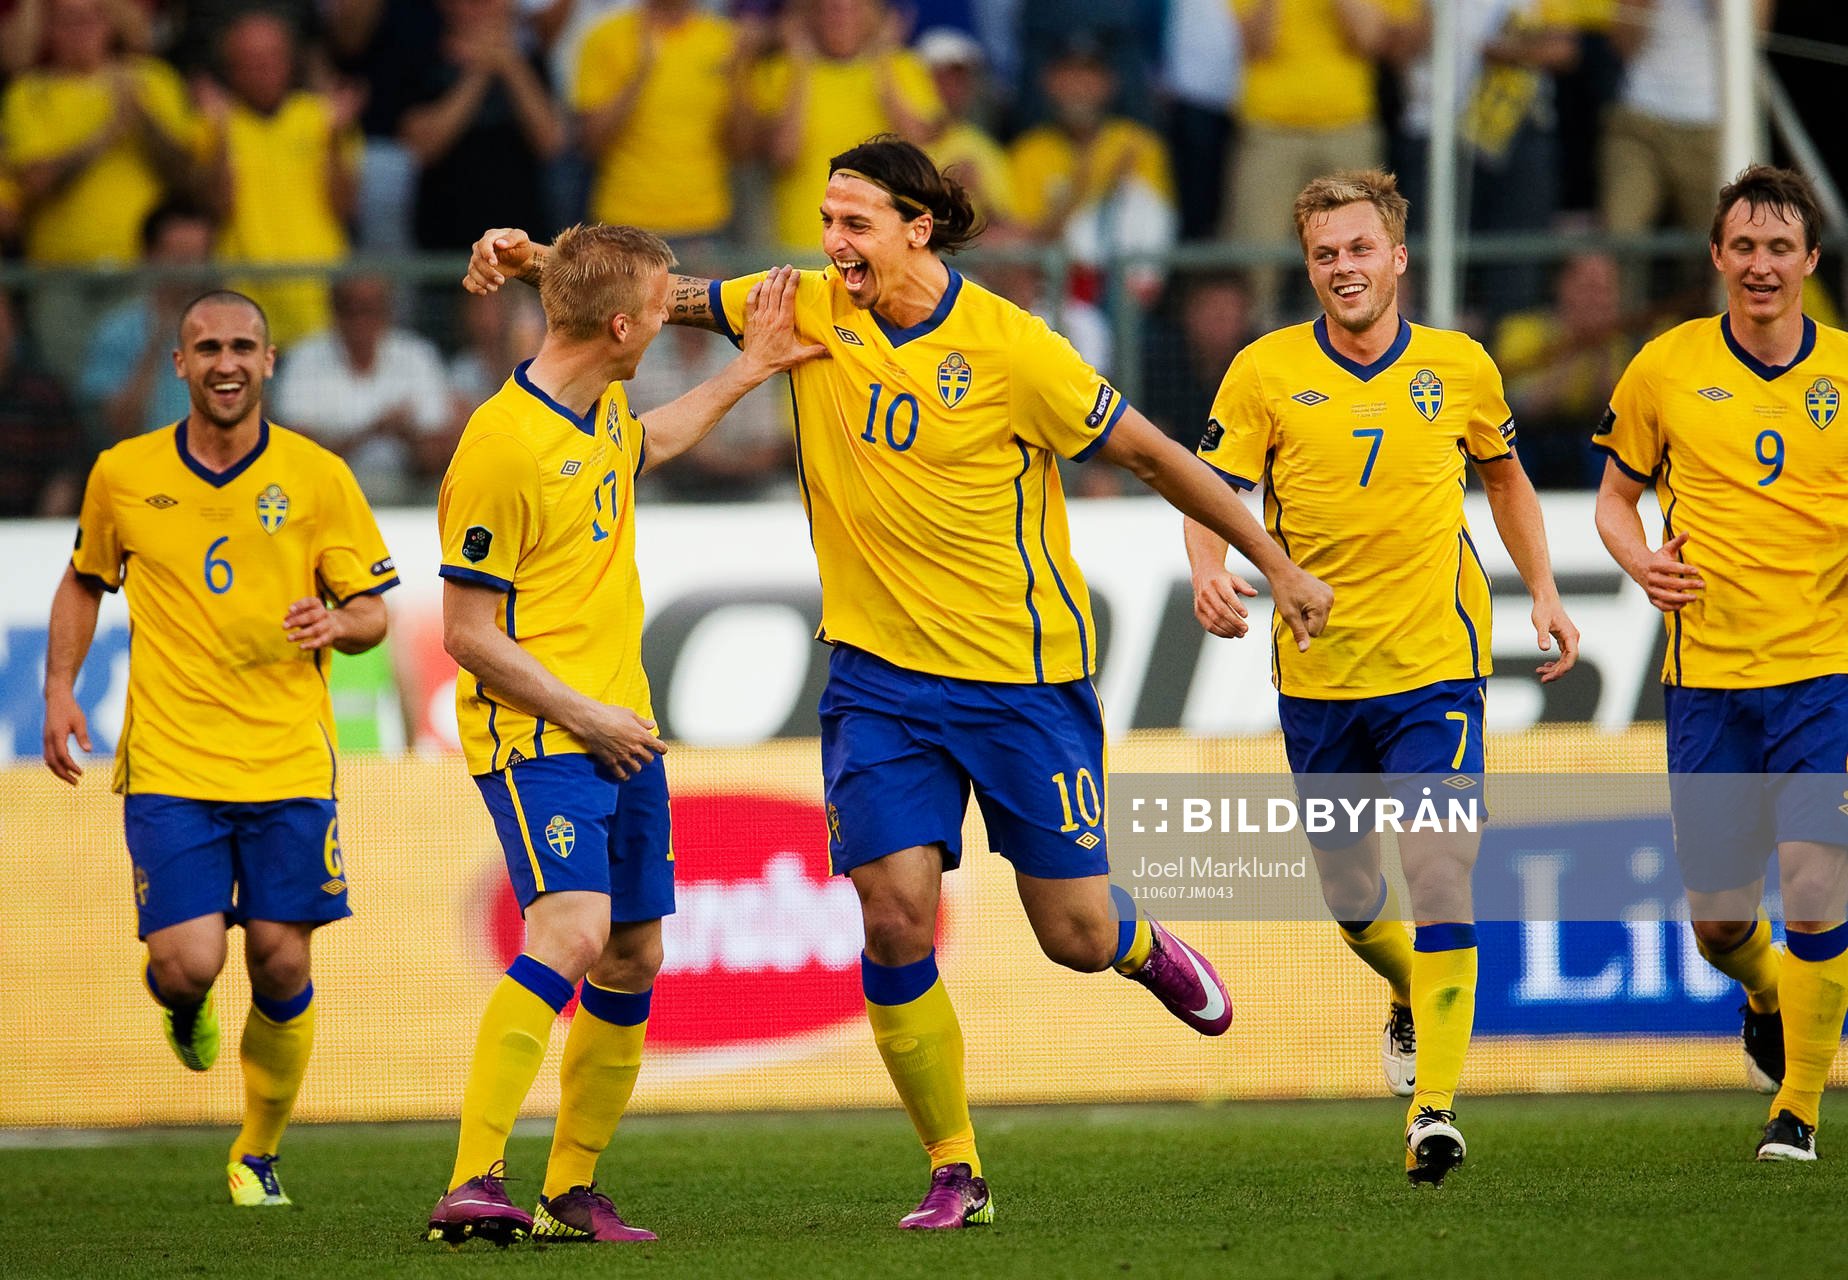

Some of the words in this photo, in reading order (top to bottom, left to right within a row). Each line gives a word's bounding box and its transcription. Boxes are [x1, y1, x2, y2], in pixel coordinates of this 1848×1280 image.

[861, 383, 919, 451] 10
[1352, 428, 1384, 488] 7
[1755, 429, 1785, 486] 9
[592, 470, 617, 542] 17
[204, 535, 233, 595] 6
[1445, 711, 1468, 770] 7
[1052, 767, 1101, 833] 10
[323, 817, 342, 878] 6
